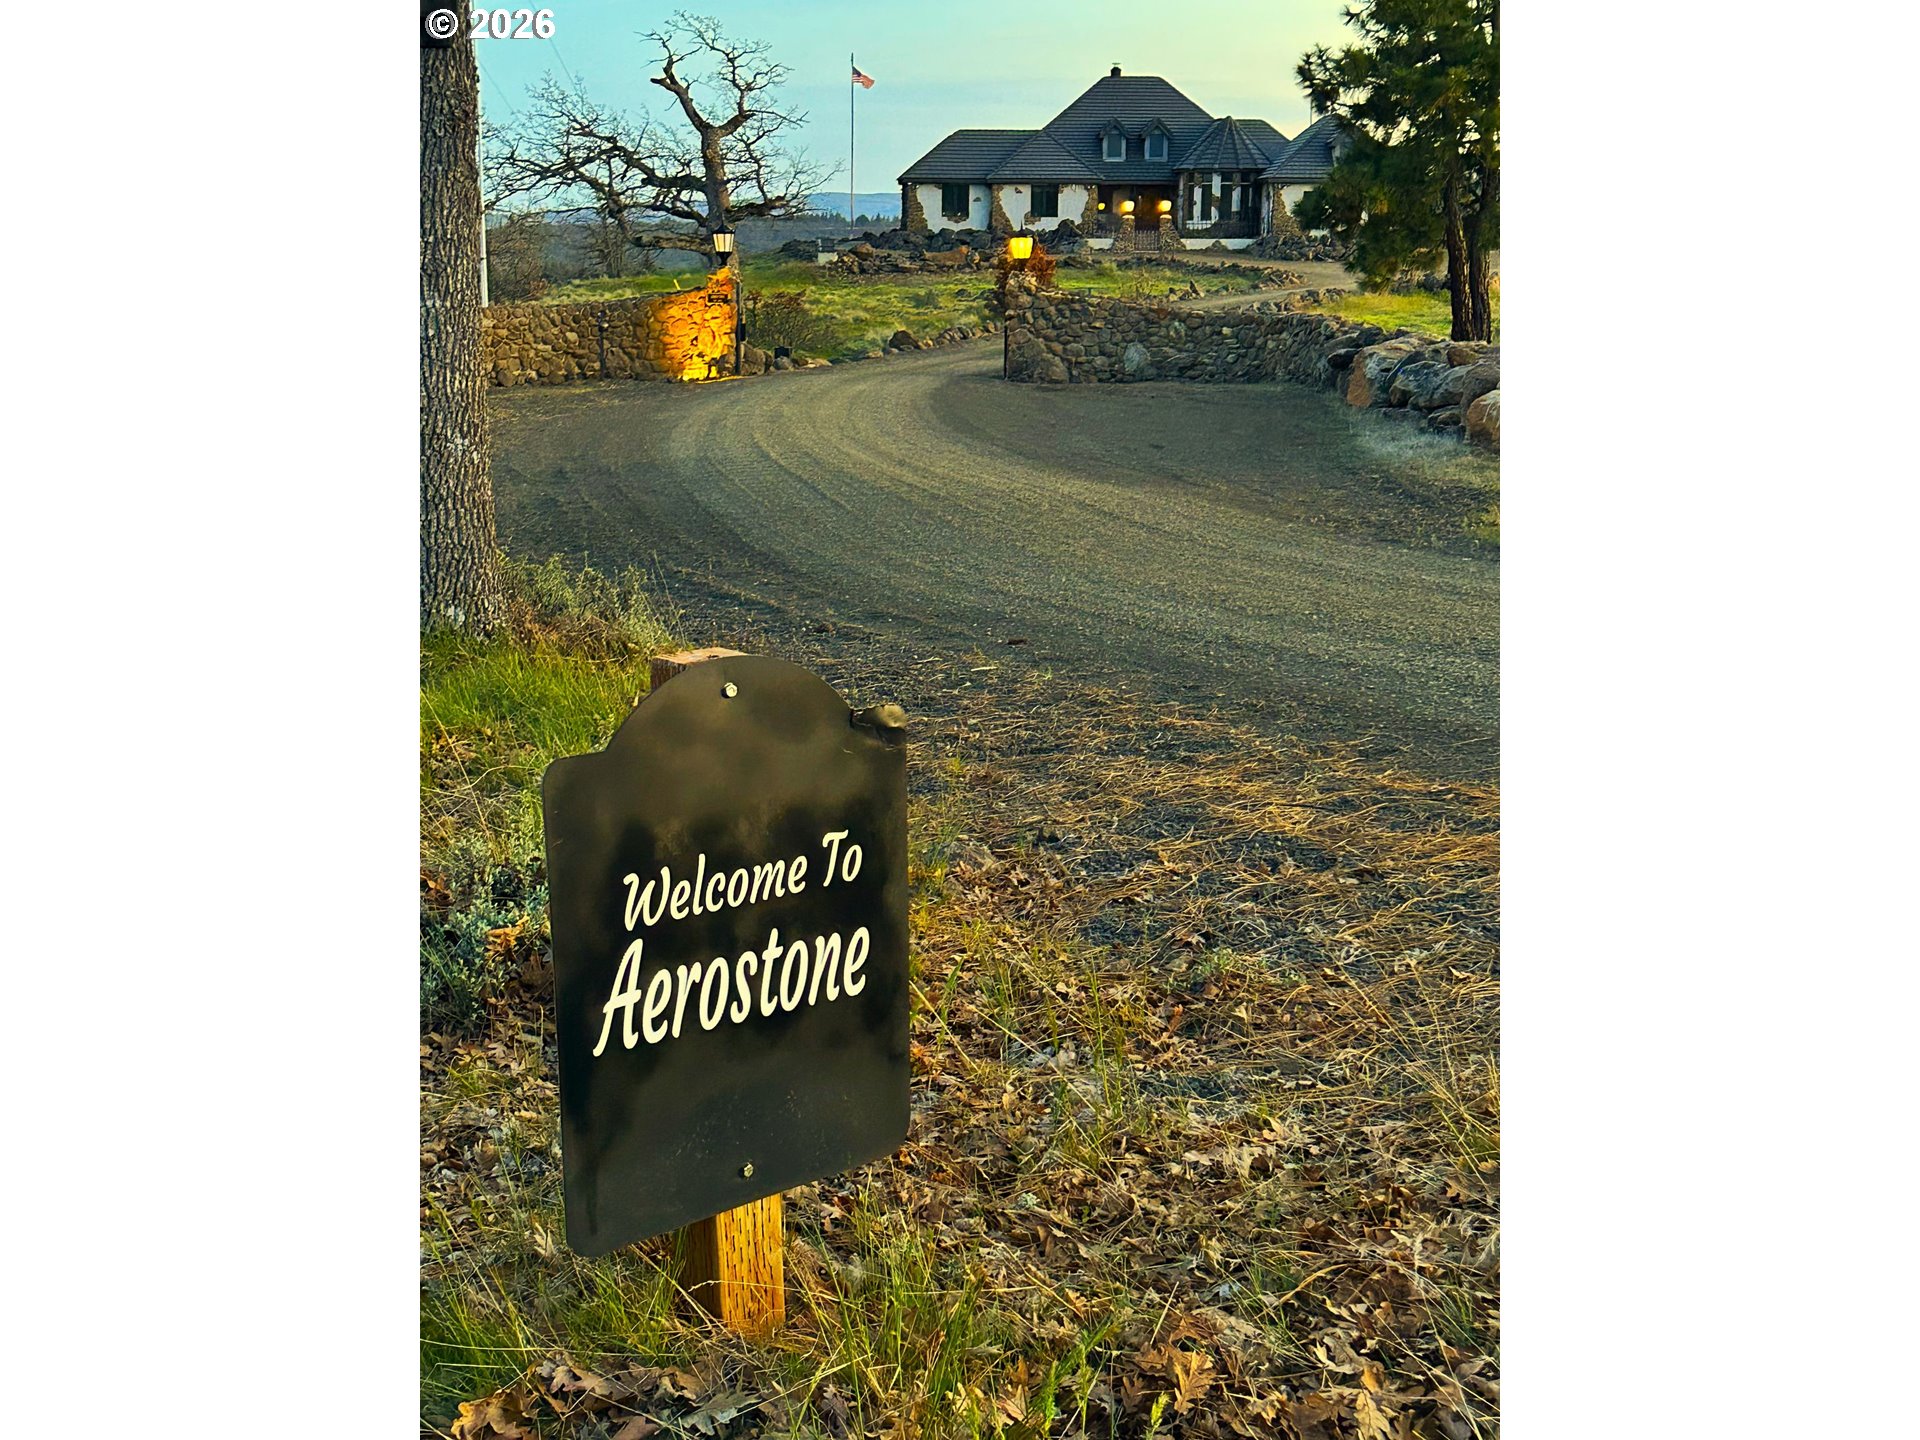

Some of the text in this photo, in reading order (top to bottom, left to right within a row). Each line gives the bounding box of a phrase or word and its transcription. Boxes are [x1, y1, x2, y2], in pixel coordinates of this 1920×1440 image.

[623, 829, 863, 931] Welcome To
[592, 926, 870, 1057] Aerostone
